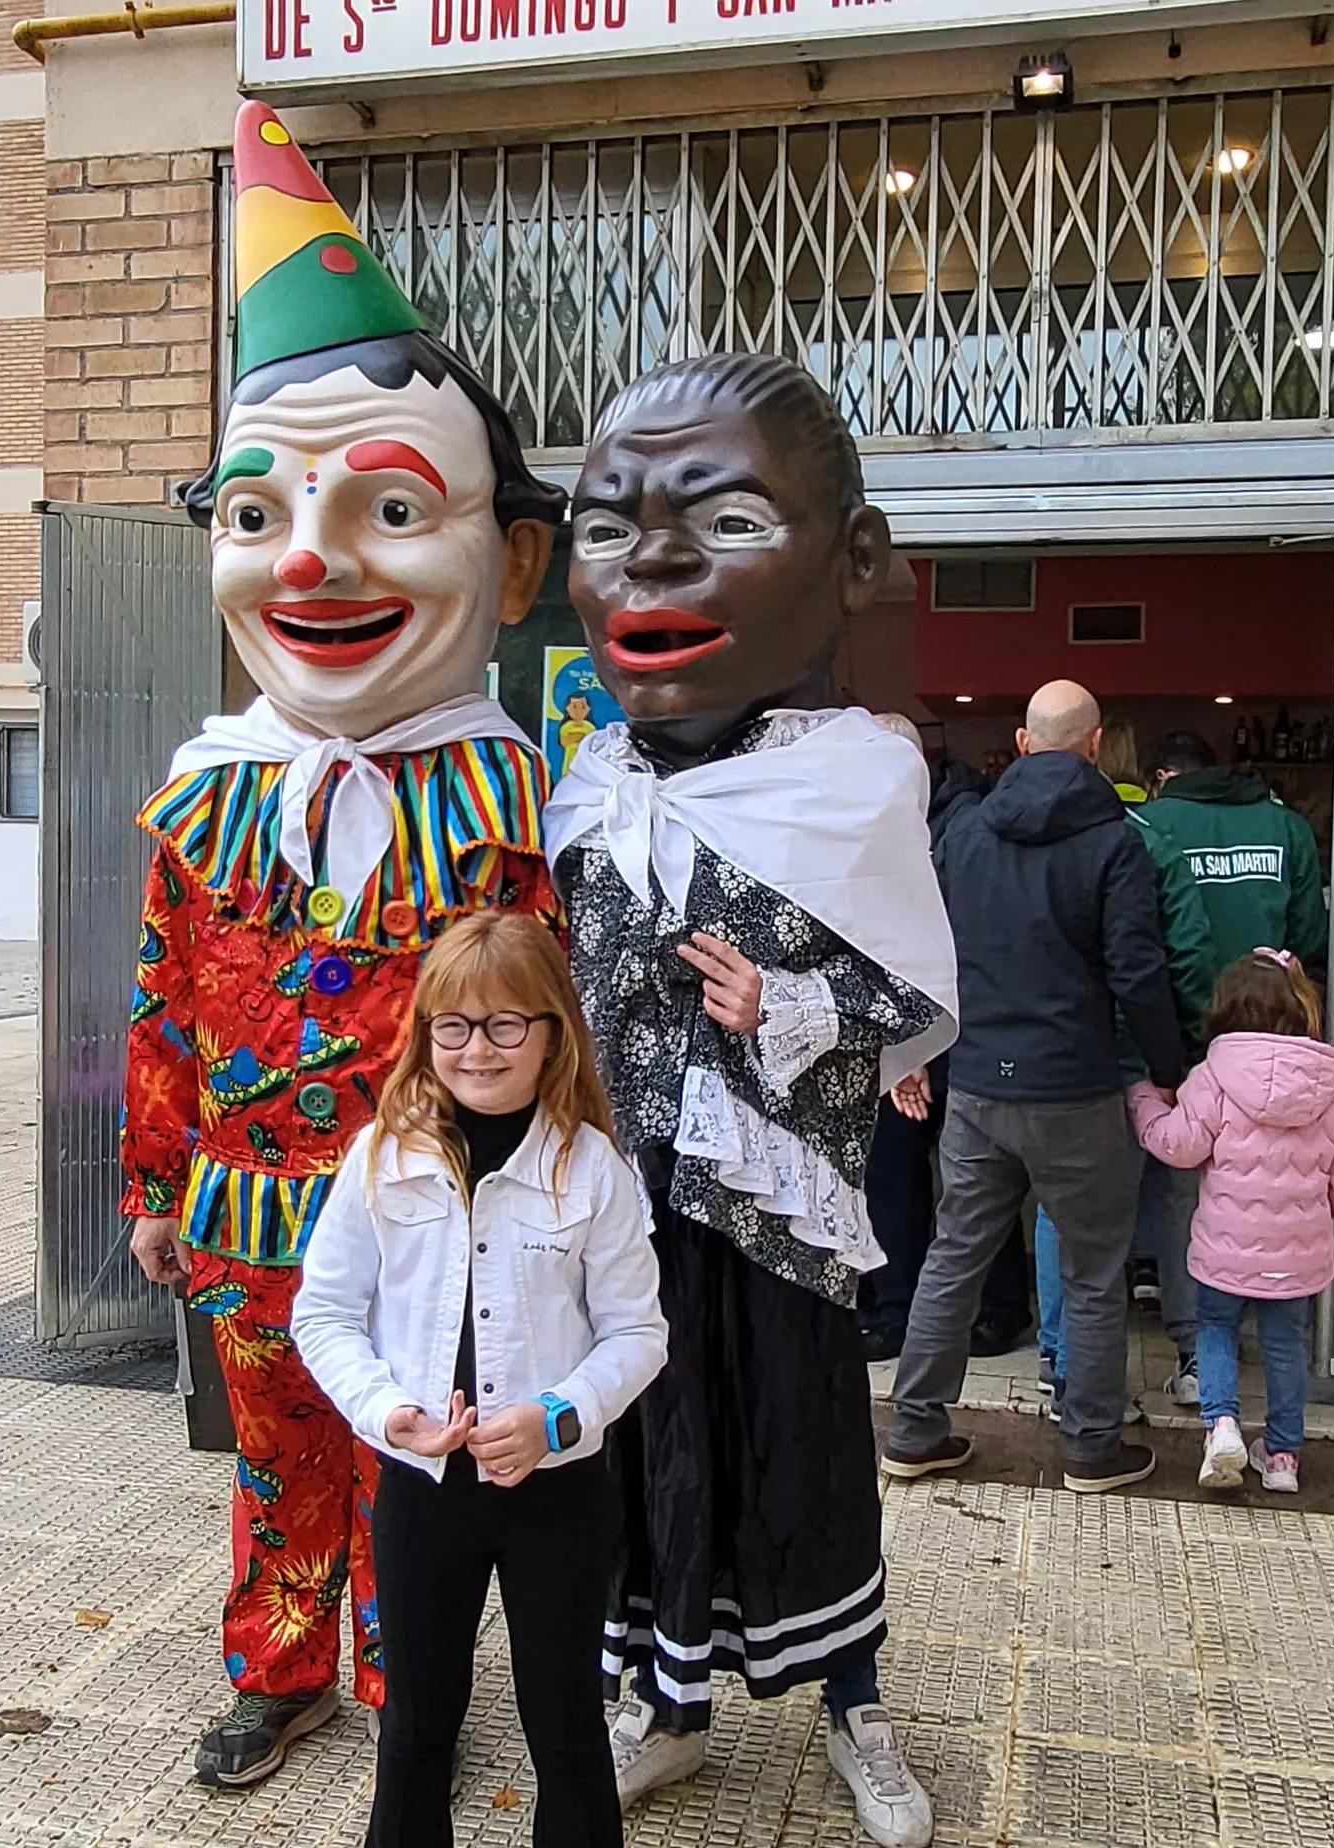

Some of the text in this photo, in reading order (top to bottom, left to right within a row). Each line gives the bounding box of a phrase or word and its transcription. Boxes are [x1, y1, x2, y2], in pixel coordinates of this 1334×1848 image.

[265, 0, 312, 60] DE
[578, 678, 604, 690] SA
[1205, 854, 1231, 876] SAN
[1232, 852, 1278, 874] MARTIN
